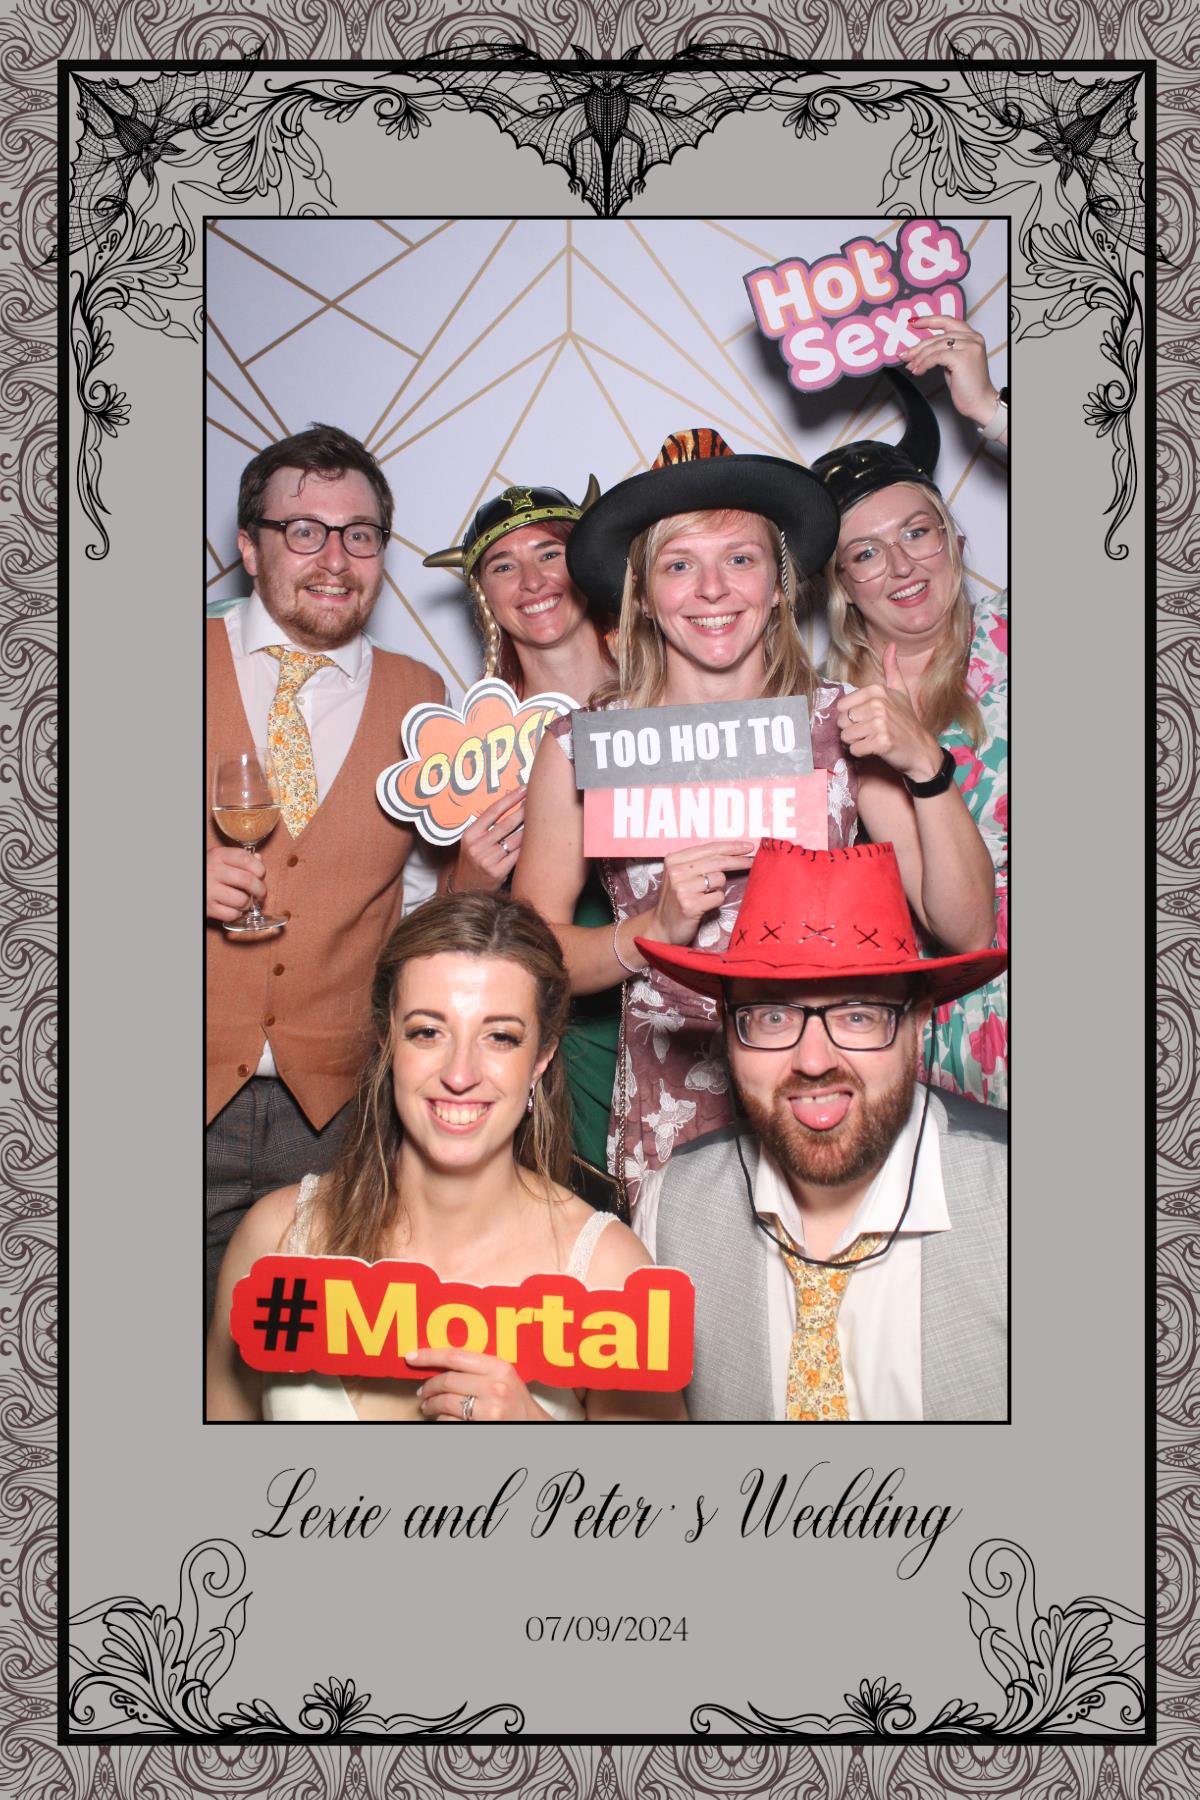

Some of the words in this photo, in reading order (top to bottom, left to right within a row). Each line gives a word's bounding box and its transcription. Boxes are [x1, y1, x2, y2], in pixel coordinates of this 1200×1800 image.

[756, 248, 891, 330] Hot
[907, 225, 960, 281] &
[589, 727, 662, 770] TOO
[669, 719, 741, 763] HOT
[747, 715, 796, 755] TO
[613, 787, 797, 839] HANDLE
[252, 1277, 671, 1372] #Mortal
